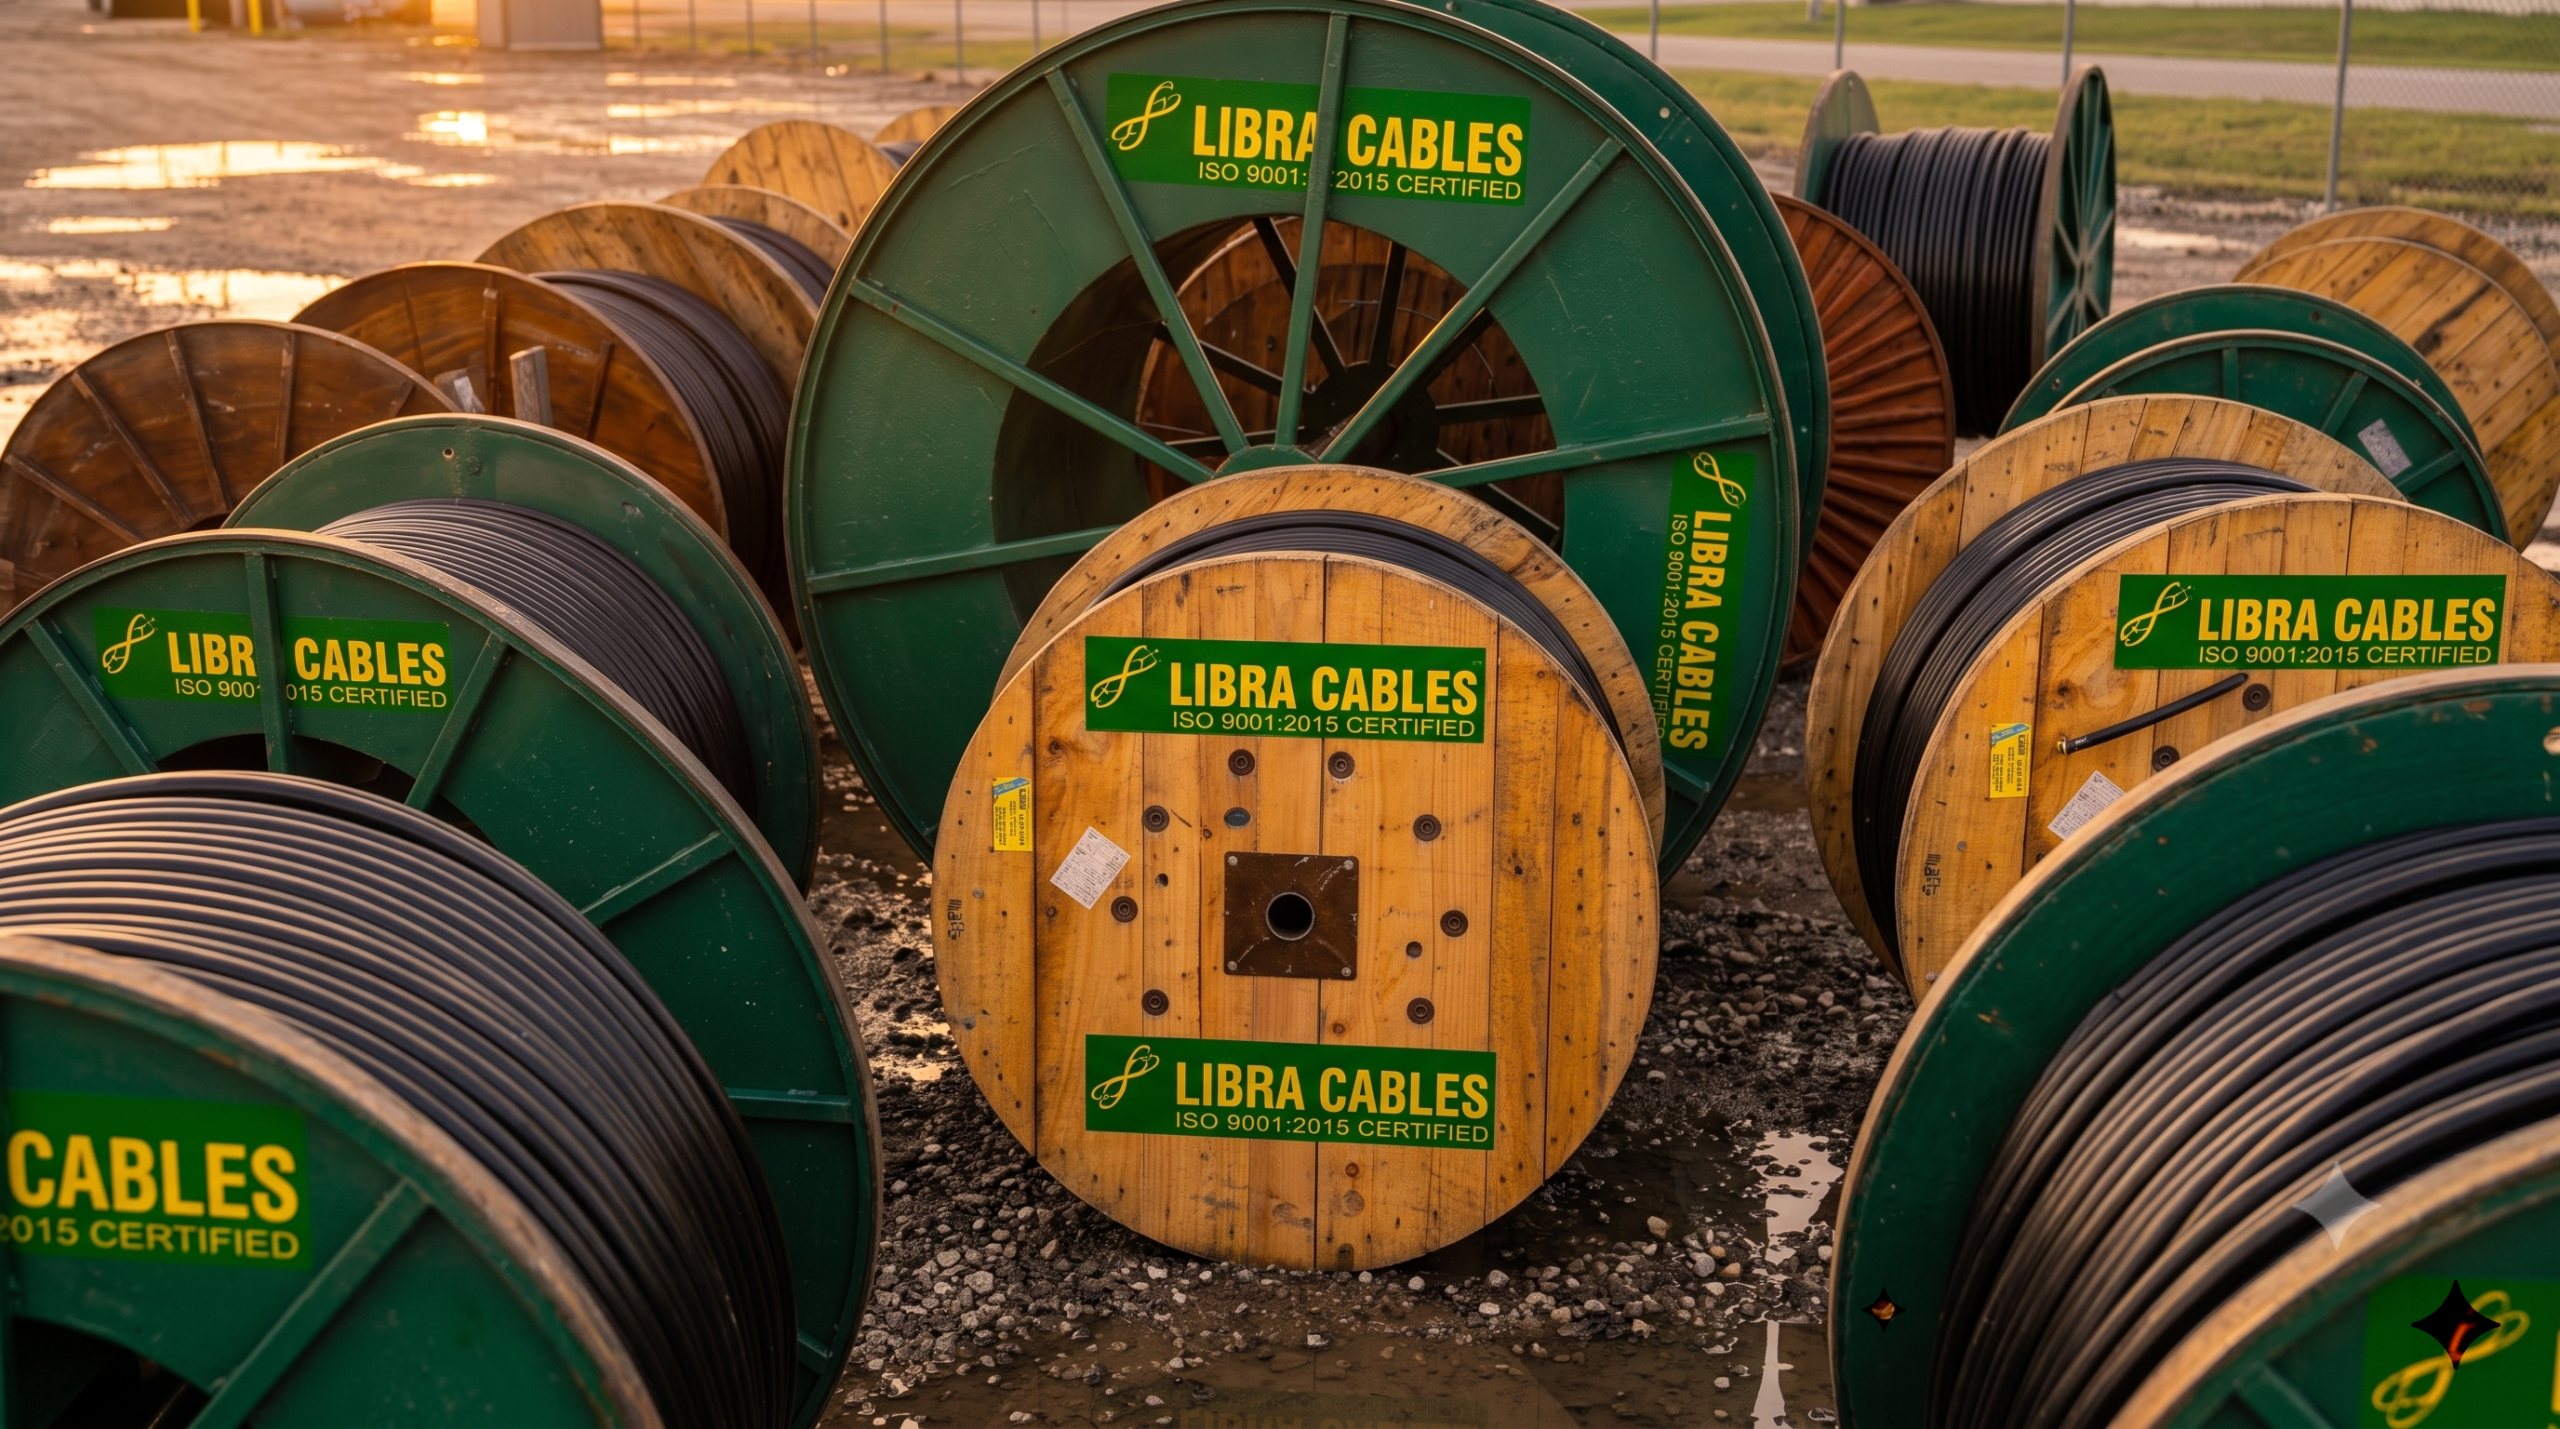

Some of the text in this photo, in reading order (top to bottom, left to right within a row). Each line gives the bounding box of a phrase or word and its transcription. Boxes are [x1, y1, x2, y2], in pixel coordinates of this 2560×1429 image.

[1193, 105, 1523, 176] LIBRA CABLES
[1199, 162, 1239, 181] ISO
[1397, 174, 1521, 199] CERTIFIED
[1671, 514, 1688, 545] ISO
[1660, 551, 1684, 639] 9001:2015
[1669, 511, 1731, 749] LIBRA CABLES
[2198, 597, 2496, 642] LIBRA CABLES
[167, 632, 446, 686] LIBR CABLES
[2199, 646, 2492, 664] ISO 9001:2015 CERTIFIED
[175, 679, 212, 696] ISO
[329, 686, 447, 708] CERTIFIED
[1170, 662, 1478, 715] LIBRA CABLES
[1173, 711, 1475, 737] ISO 9001:2015 CERTIFIED
[1176, 1062, 1489, 1119] LIBRA CABLES
[1176, 1111, 1489, 1143] ISO 9001:2015 CERTIFIED
[7, 1129, 299, 1223] CABLES
[89, 1219, 299, 1260] CERTIFIED
